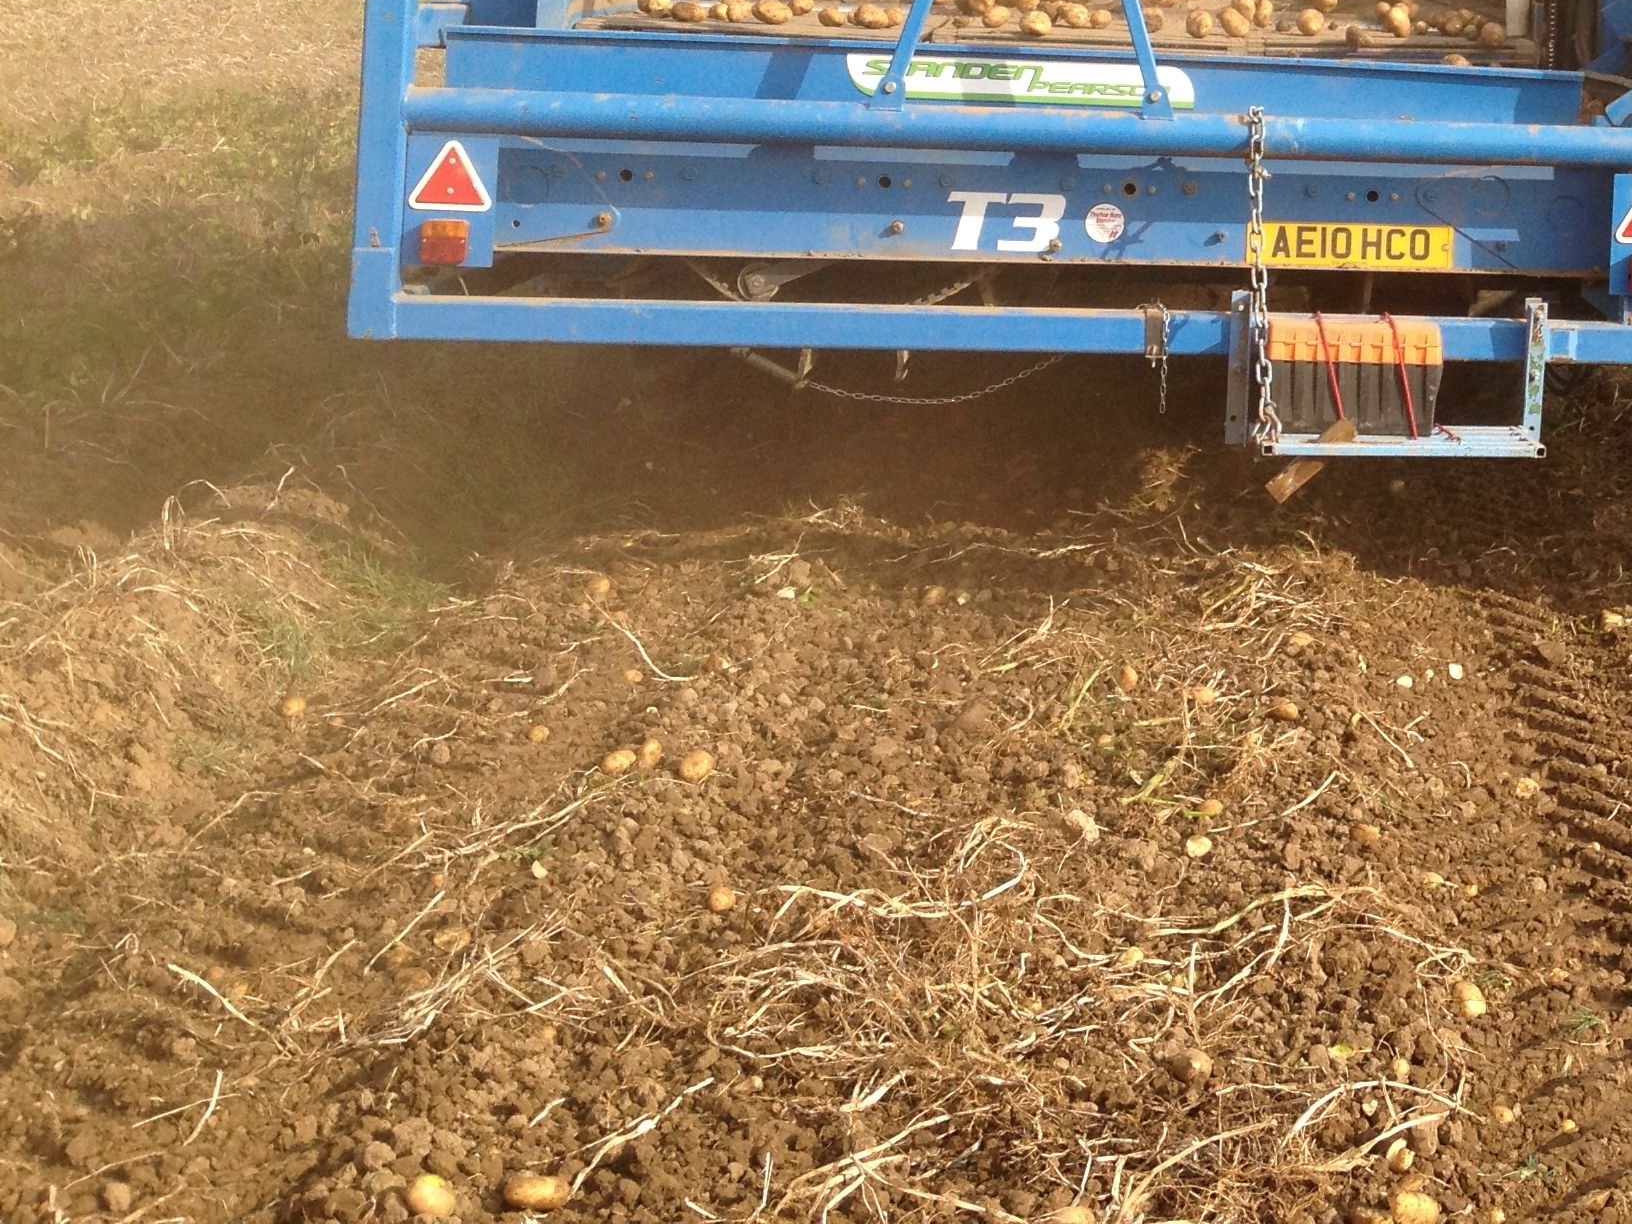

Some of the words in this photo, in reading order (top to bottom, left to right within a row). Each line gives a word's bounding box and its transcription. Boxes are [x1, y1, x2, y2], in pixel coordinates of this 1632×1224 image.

[862, 59, 1043, 86] SANDEN
[1027, 79, 1171, 96] PEARSO
[947, 191, 1067, 252] T3
[1271, 225, 1352, 259] AE10
[1361, 227, 1430, 260] HCO
